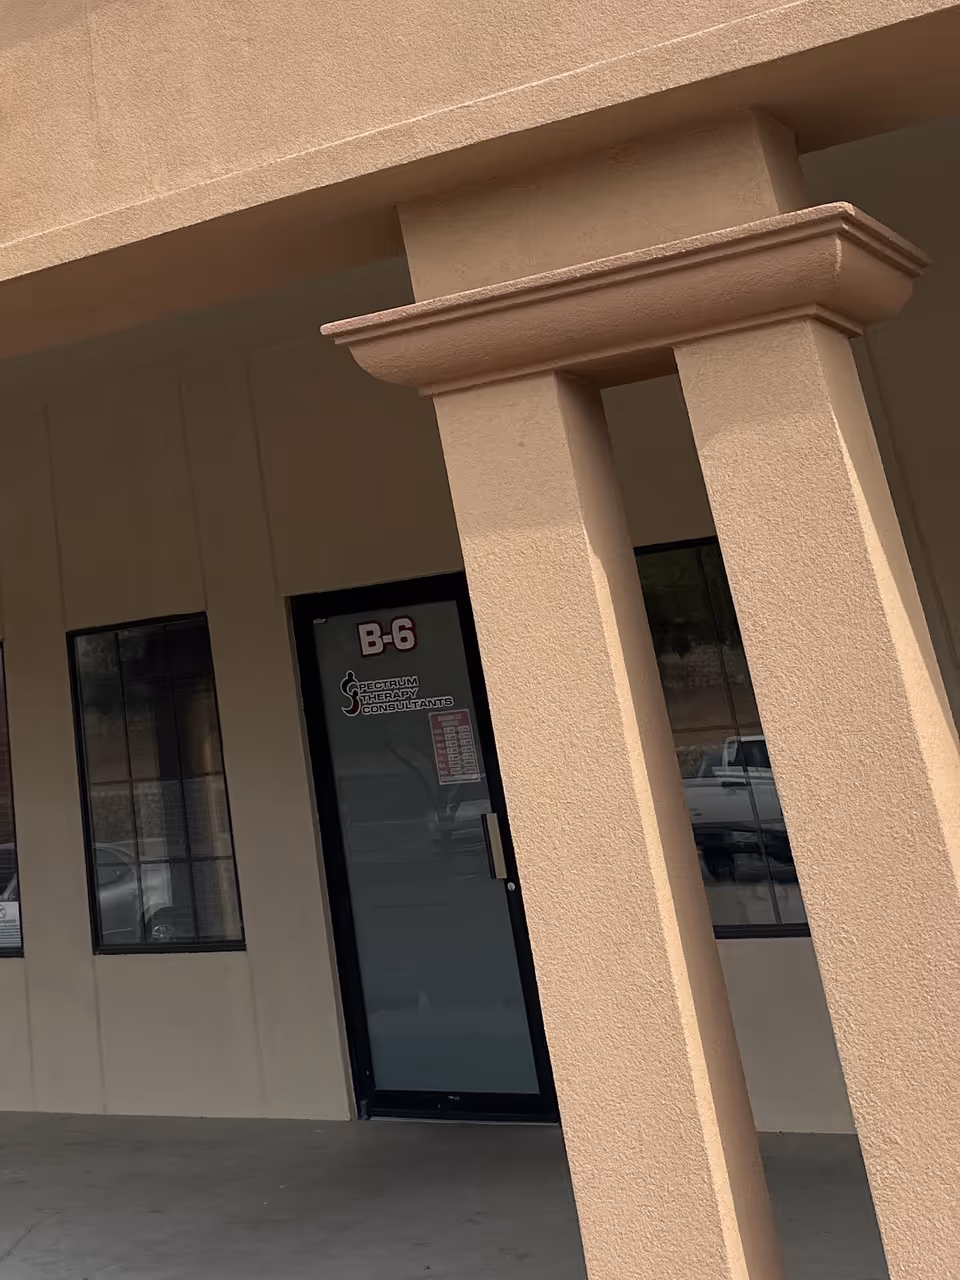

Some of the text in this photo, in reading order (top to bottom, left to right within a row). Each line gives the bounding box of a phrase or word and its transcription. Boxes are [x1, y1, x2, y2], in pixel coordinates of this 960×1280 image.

[357, 617, 417, 657] B-6
[360, 687, 419, 704] THERAPY
[361, 696, 454, 715] CONSULTANTS
